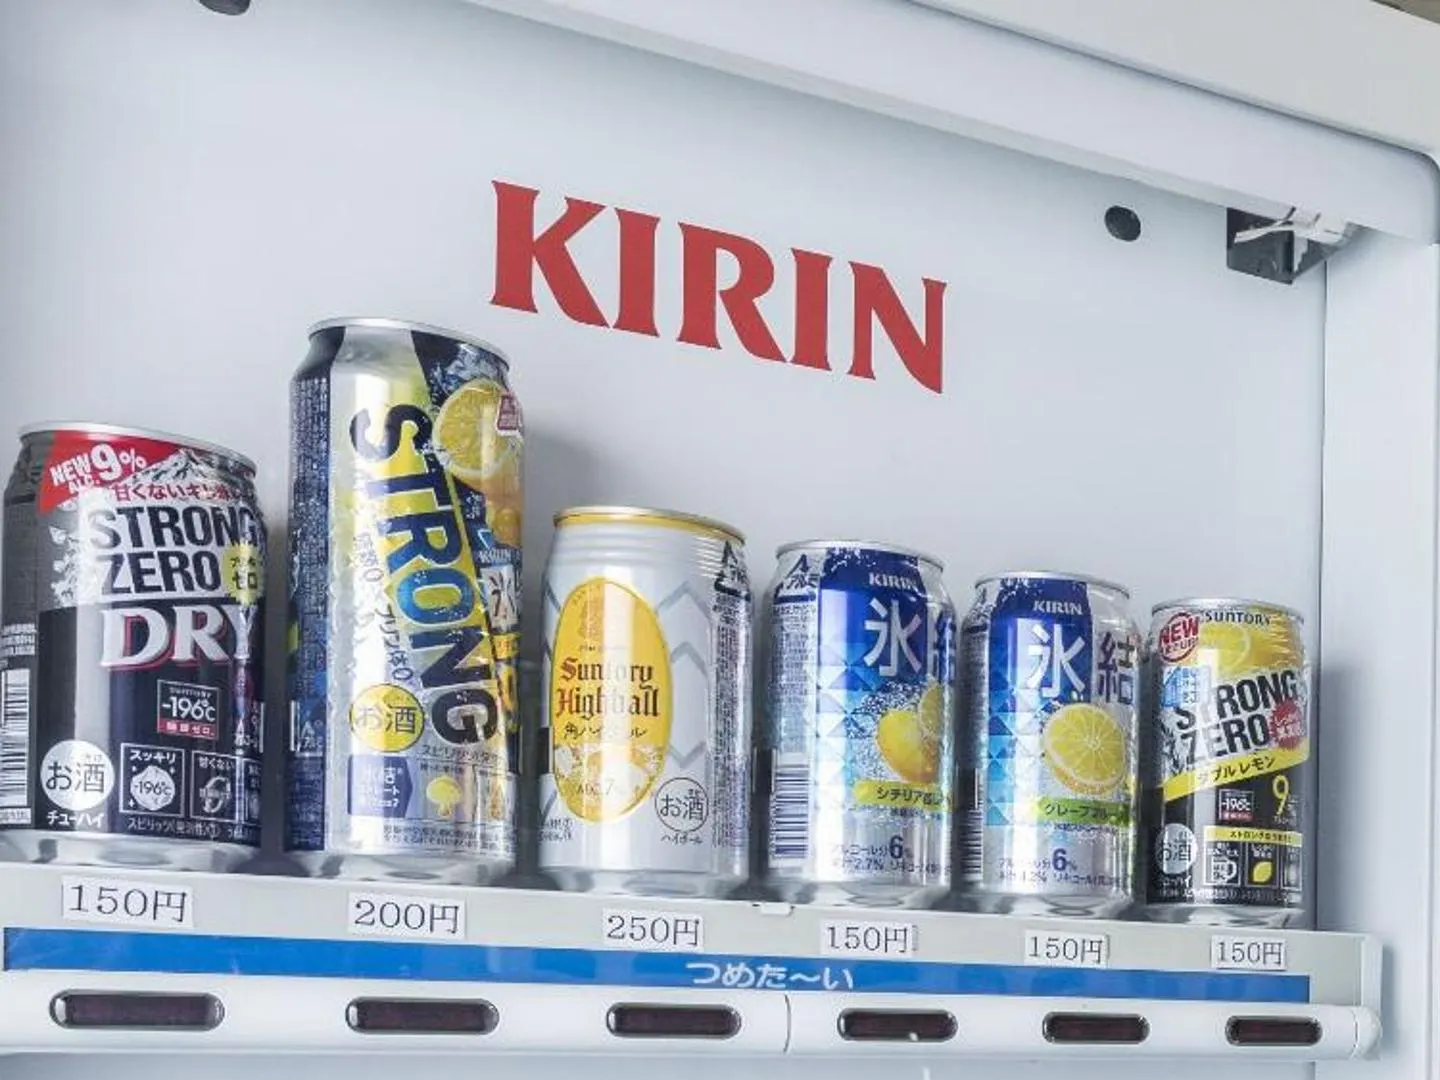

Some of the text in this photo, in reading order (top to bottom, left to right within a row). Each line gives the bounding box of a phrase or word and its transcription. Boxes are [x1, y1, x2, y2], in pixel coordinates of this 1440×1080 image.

[491, 179, 947, 394] KIRIN
[50, 454, 91, 486] NEW
[87, 505, 260, 549] STRONG
[96, 550, 222, 596] ZERO
[350, 404, 499, 746] STRONG
[869, 572, 918, 590] KIRIN
[1033, 600, 1082, 616] KIRIN
[1204, 609, 1271, 626] SUNTORY
[101, 604, 260, 672] DRY
[1160, 616, 1199, 645] NEW
[560, 657, 654, 690] Suntory
[353, 703, 417, 734] お酒
[129, 750, 176, 764] スッキリ
[46, 758, 105, 793] お酒
[46, 810, 105, 829] チューハイ
[660, 793, 704, 821] お酒
[66, 883, 190, 926] 150円
[353, 898, 460, 935] 200円
[605, 914, 700, 947] 250円
[827, 926, 909, 954] 150円
[1029, 935, 1104, 964] 150円
[1215, 940, 1286, 968] 150円
